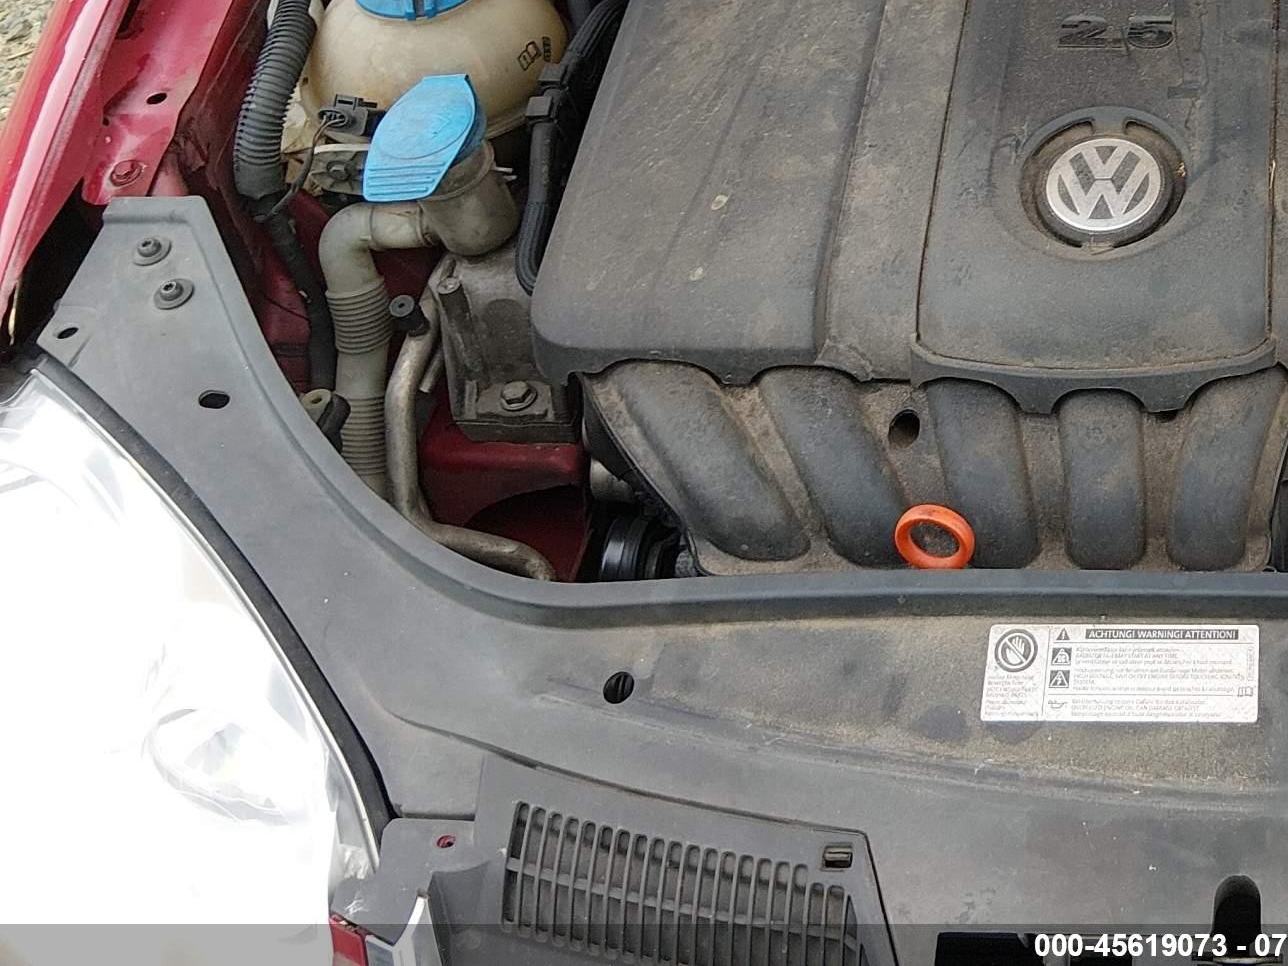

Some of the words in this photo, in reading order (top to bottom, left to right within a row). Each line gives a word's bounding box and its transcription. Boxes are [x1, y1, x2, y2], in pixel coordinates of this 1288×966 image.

[1050, 141, 1157, 227] VW
[1088, 629, 1136, 639] ACHTUNG!
[1137, 629, 1183, 639] WARNING!
[1184, 630, 1236, 640] ATTENTION!
